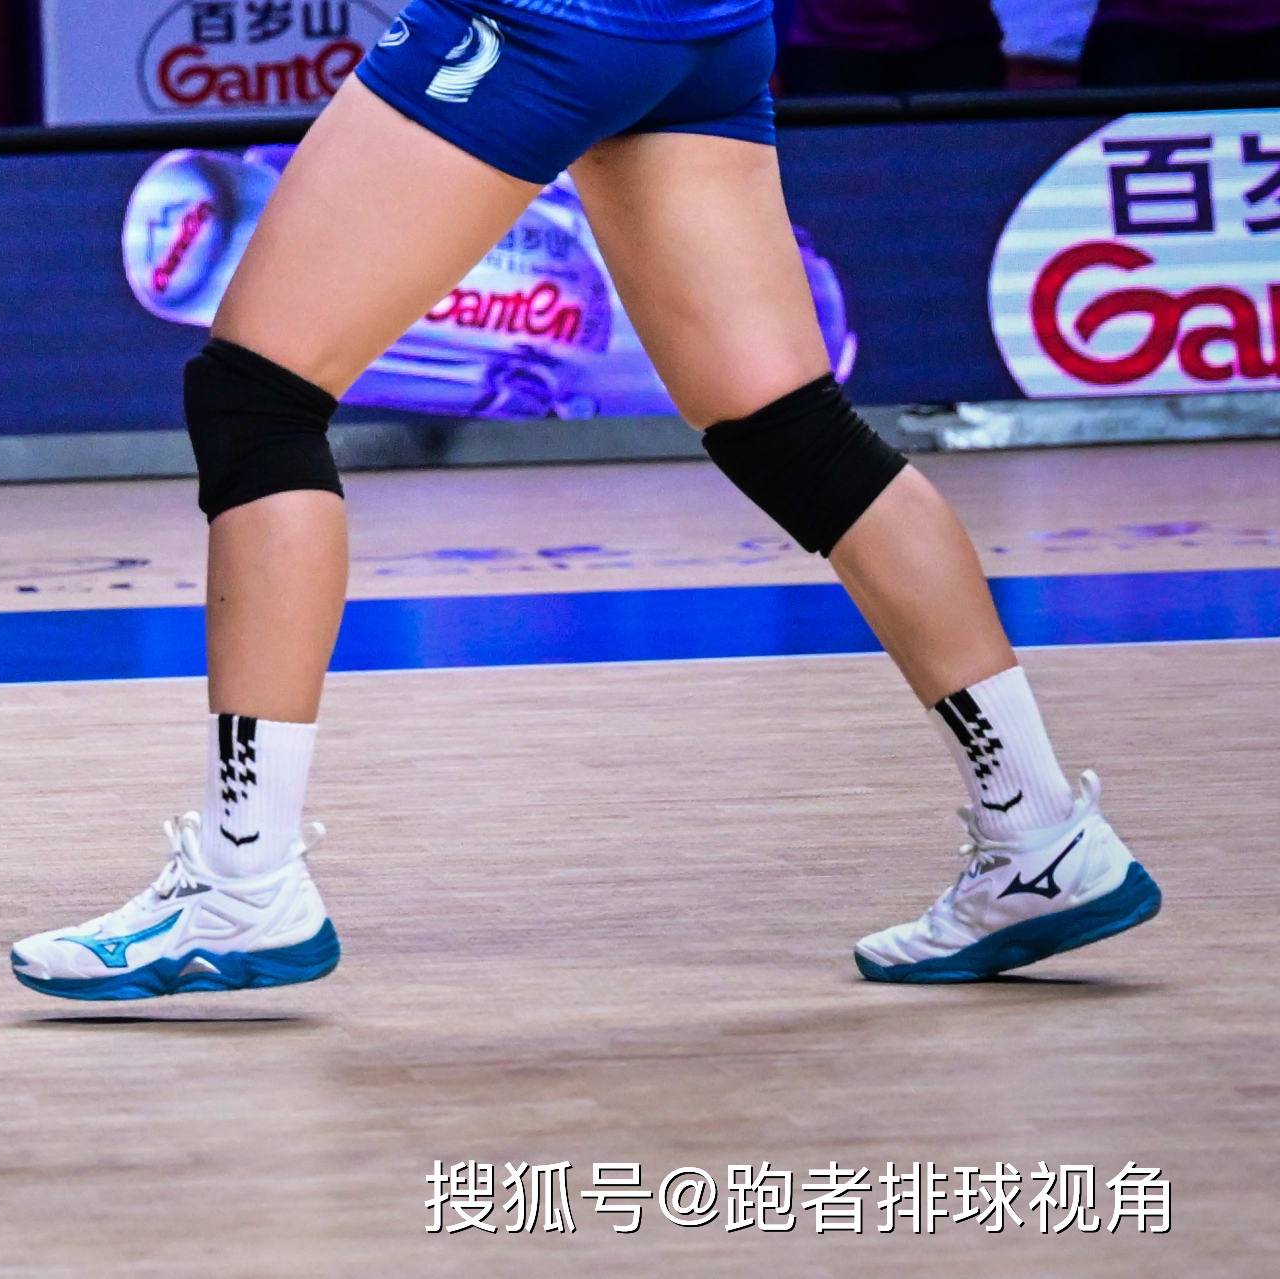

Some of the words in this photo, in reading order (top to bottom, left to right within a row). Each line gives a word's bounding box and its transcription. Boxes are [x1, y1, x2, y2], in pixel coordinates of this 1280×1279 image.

[192, 0, 349, 45] 百岁山
[1031, 241, 1280, 386] Ga
